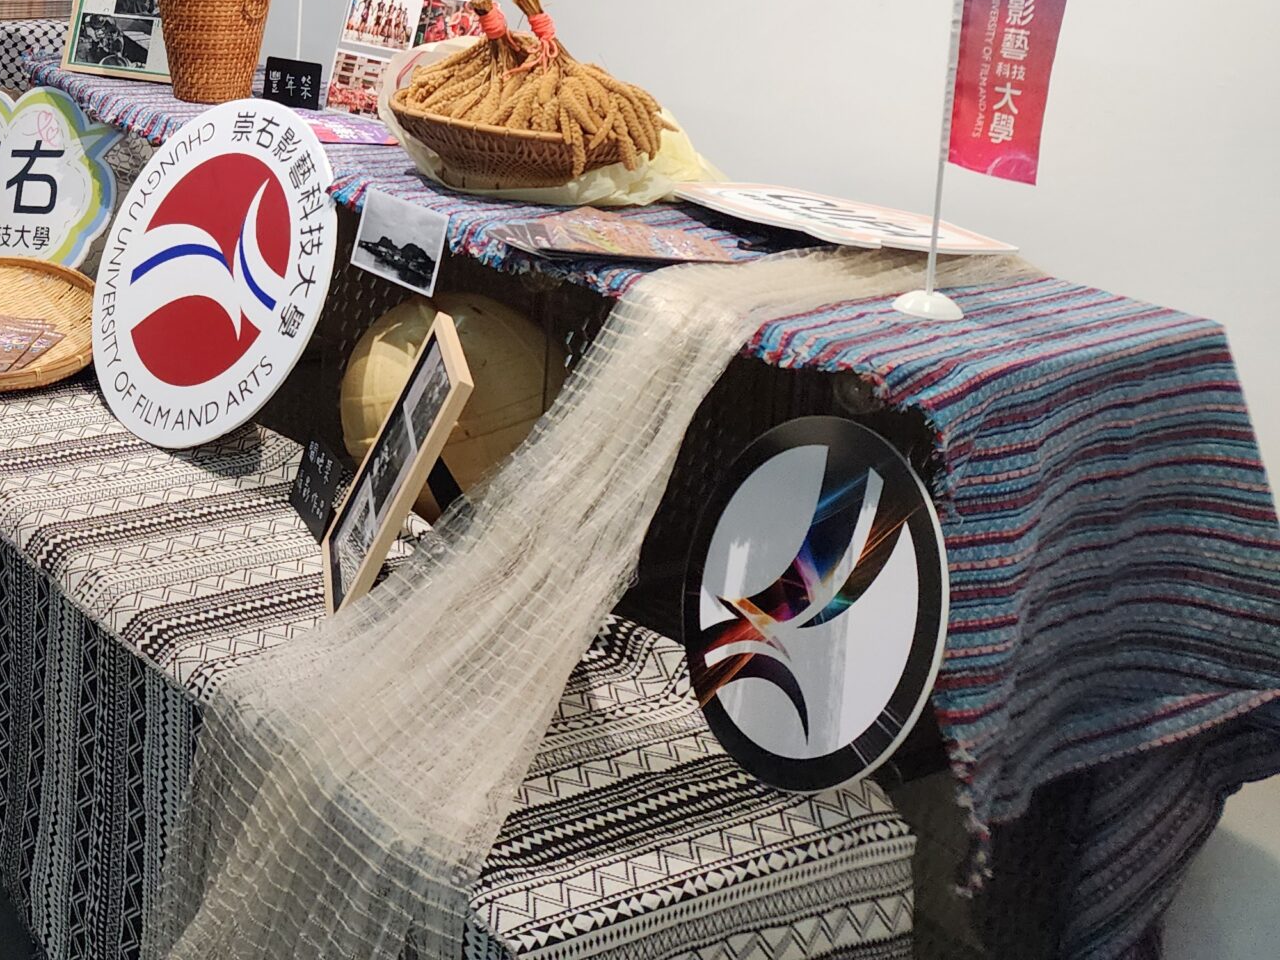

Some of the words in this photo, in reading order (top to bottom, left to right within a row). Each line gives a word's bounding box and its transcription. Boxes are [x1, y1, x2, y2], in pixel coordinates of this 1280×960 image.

[231, 112, 323, 338] 崇右影藝科技大學
[101, 227, 129, 367] UNIVERSITY
[114, 371, 138, 403] OF
[225, 356, 273, 415] ARTS
[130, 394, 171, 429] FILM
[169, 401, 219, 431] AND
